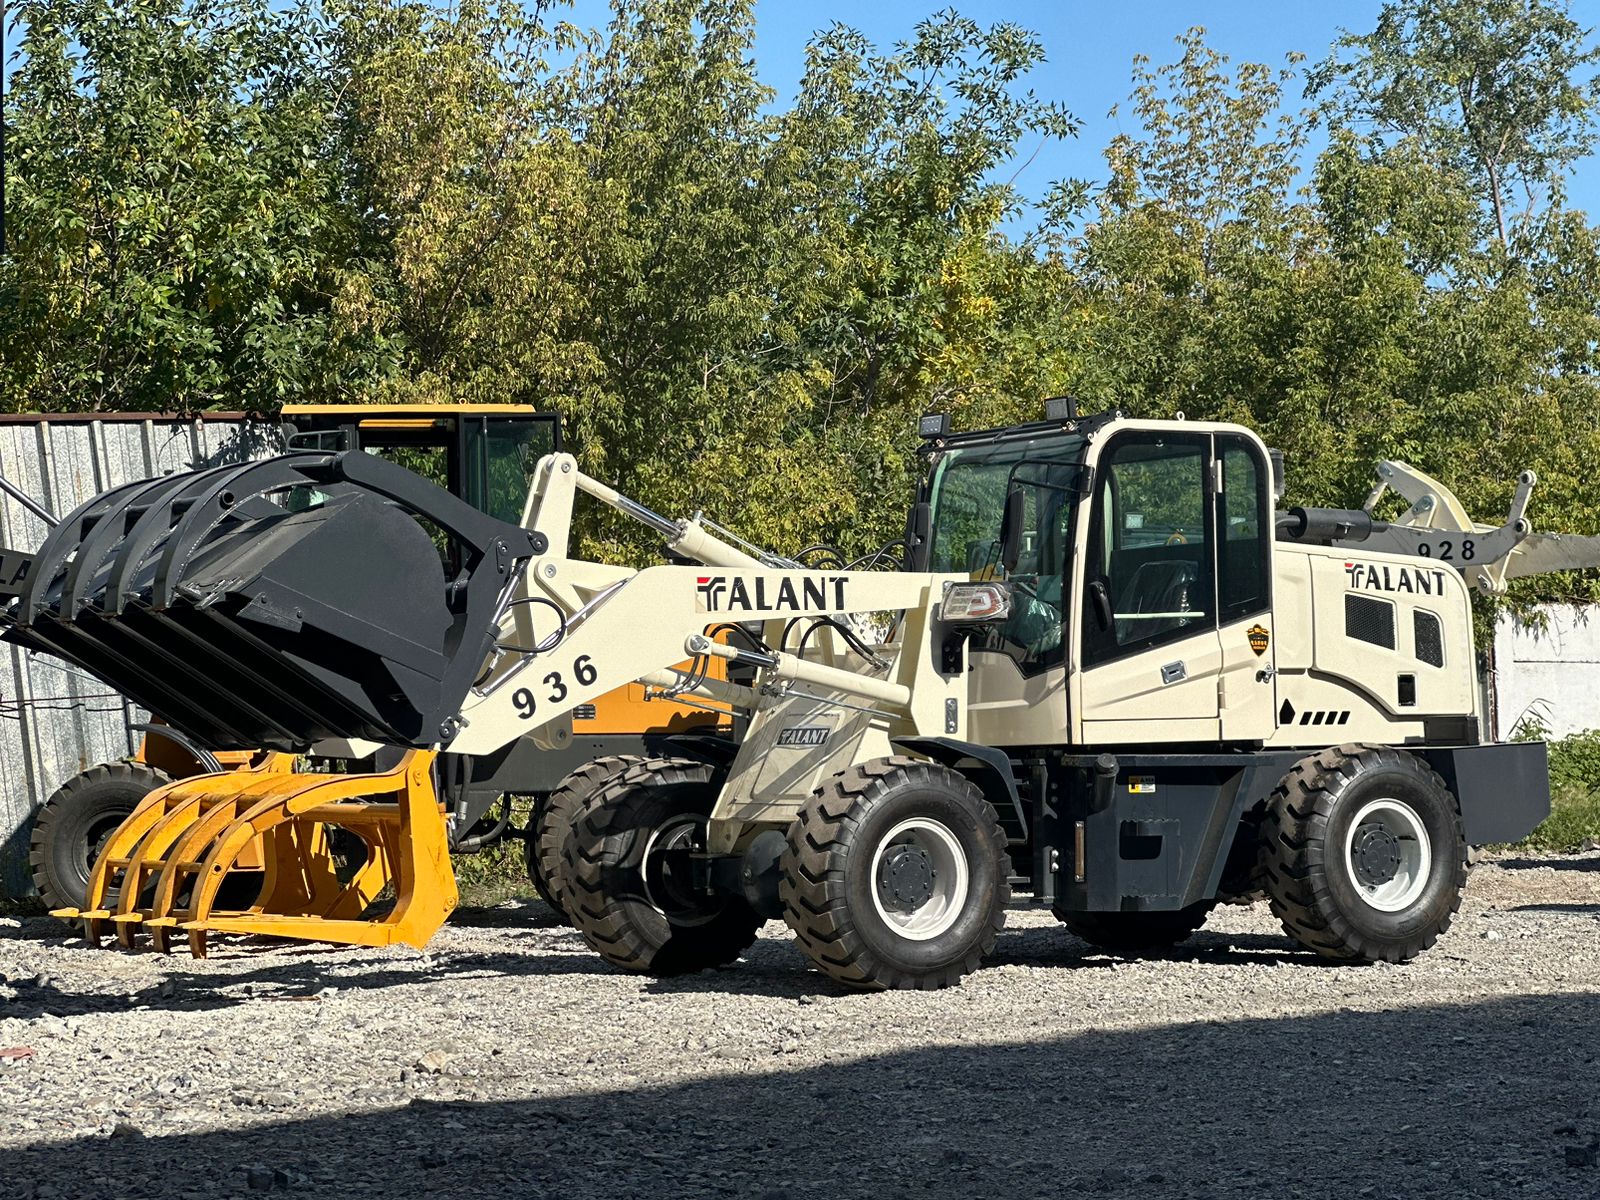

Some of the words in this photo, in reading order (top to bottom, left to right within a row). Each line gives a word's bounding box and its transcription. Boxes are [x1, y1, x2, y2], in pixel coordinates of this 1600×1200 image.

[1417, 540, 1475, 560] 928
[697, 576, 849, 611] TALANT
[1344, 562, 1445, 596] TALANT
[511, 654, 598, 720] 936
[780, 729, 829, 744] TALANT
